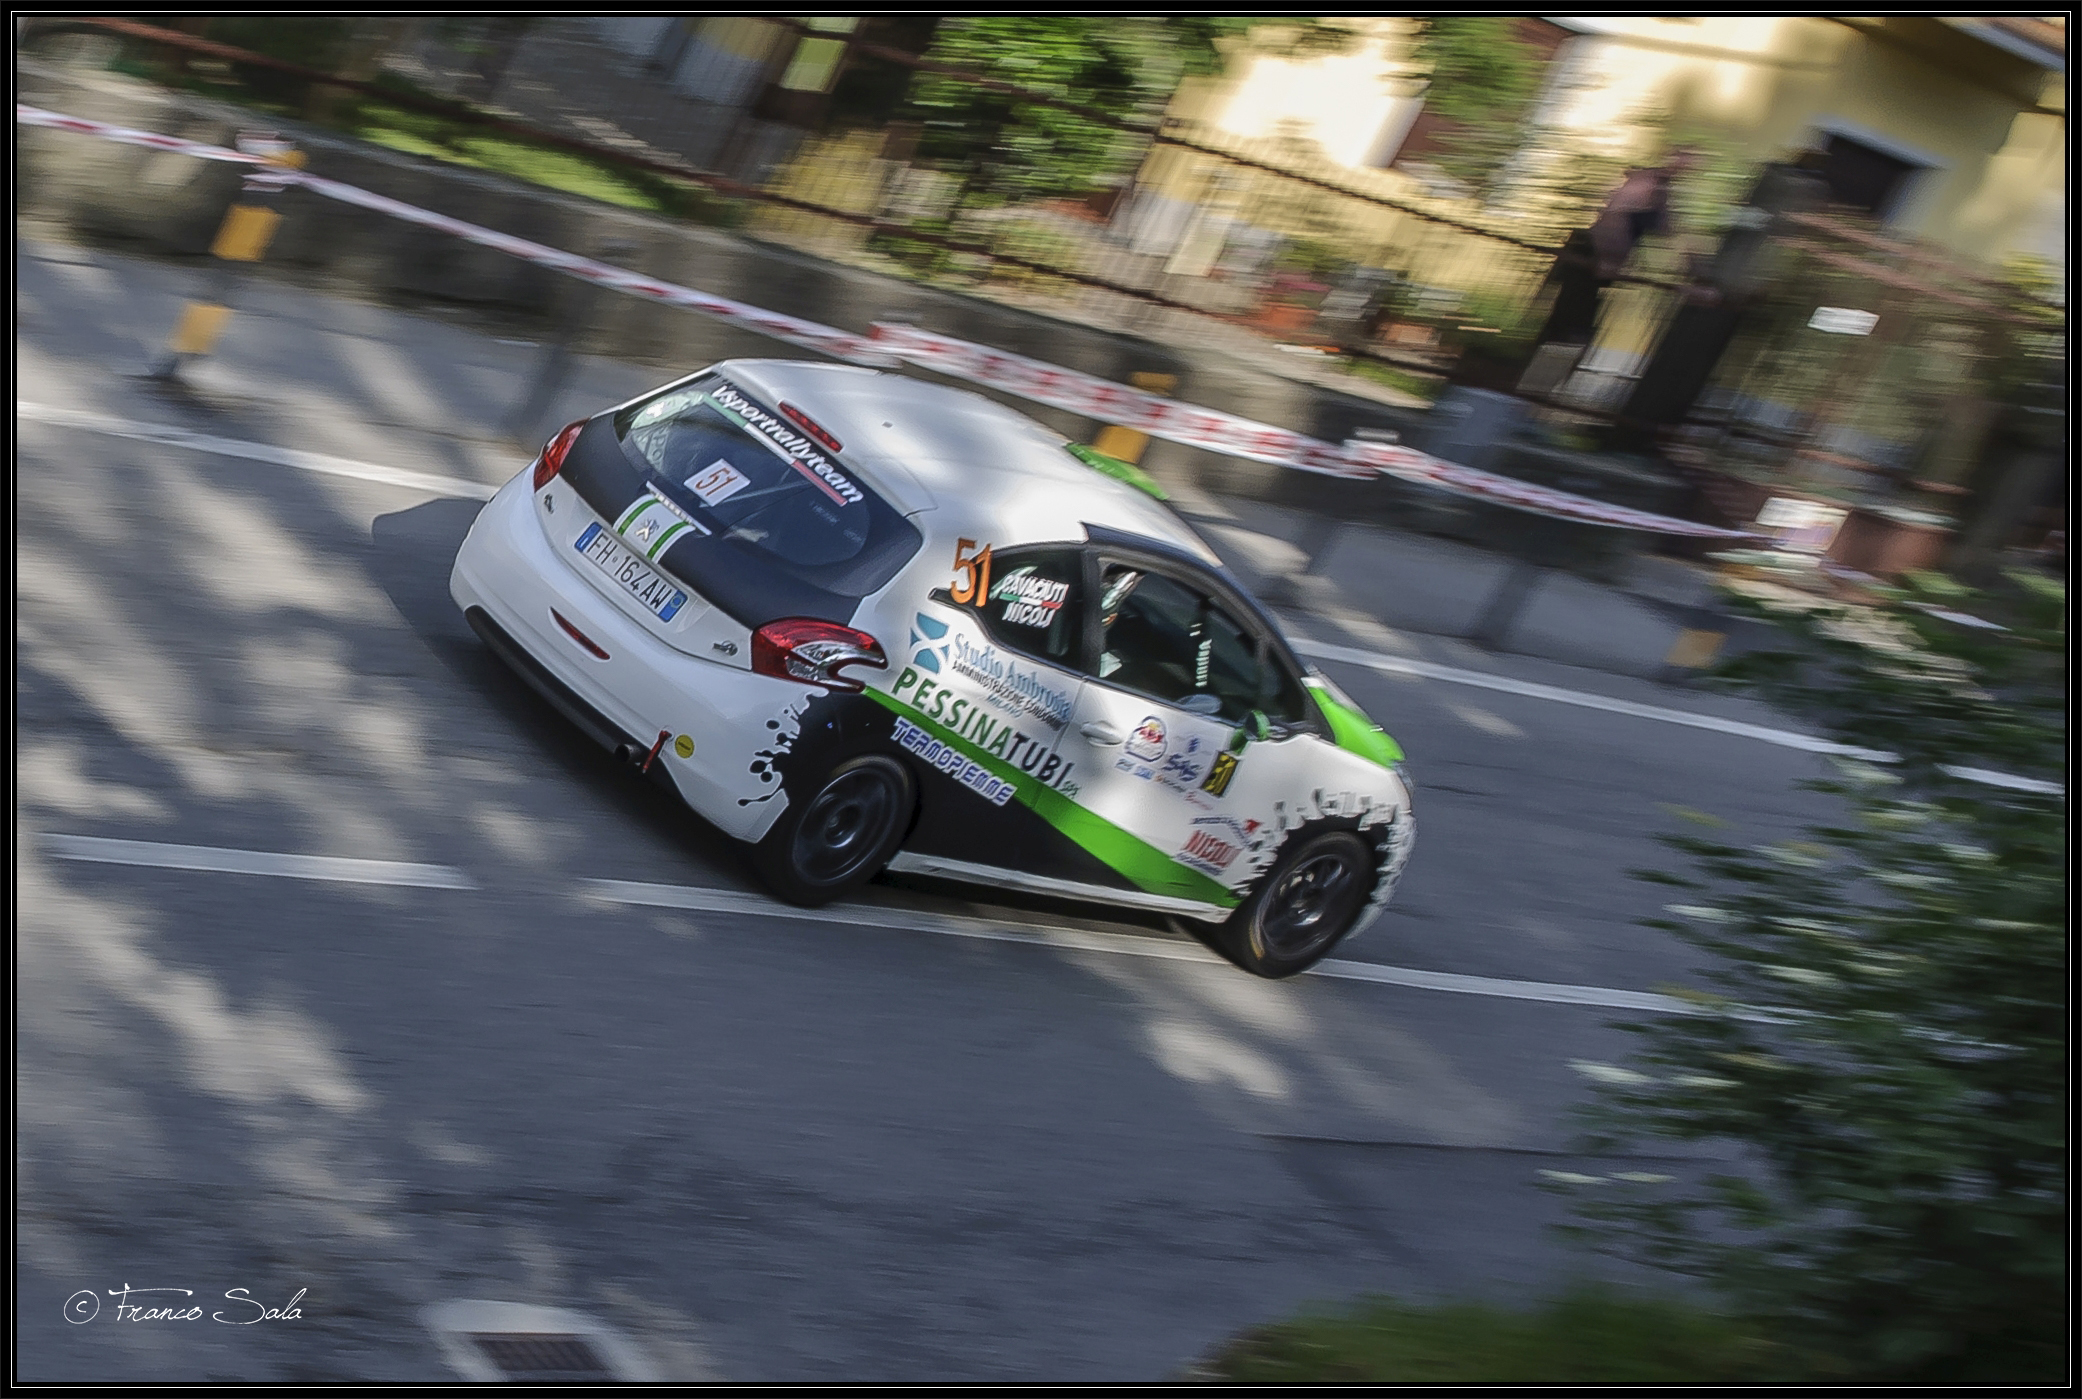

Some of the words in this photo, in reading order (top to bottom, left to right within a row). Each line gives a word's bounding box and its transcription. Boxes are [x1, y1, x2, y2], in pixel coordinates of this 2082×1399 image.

[695, 467, 738, 497] 51
[950, 537, 992, 608] 51
[1002, 602, 1057, 629] NICOLI
[953, 632, 1004, 680] Studio
[891, 716, 1017, 806] TERMOPIEMME
